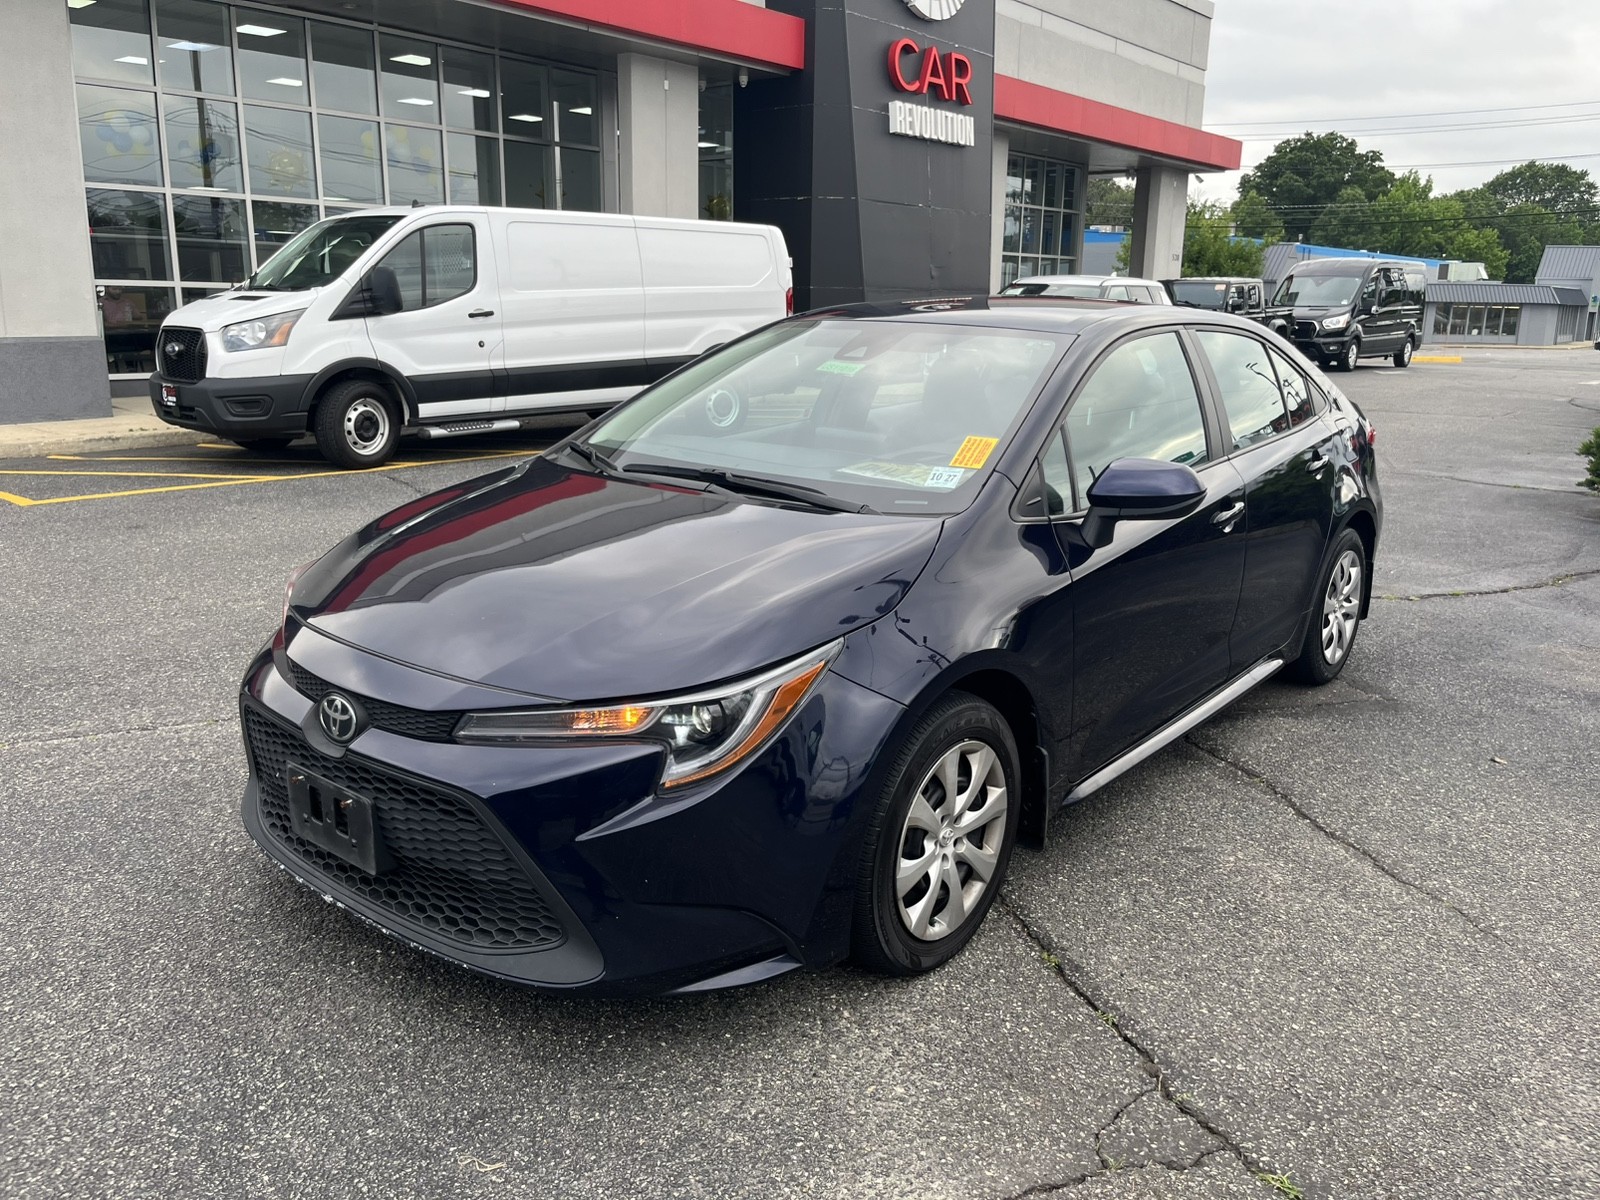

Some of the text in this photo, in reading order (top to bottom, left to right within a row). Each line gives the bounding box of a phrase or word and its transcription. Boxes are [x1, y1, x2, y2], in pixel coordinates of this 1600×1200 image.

[888, 38, 973, 106] CAR
[889, 100, 975, 146] REVOLUTION
[930, 472, 957, 482] 10 27
